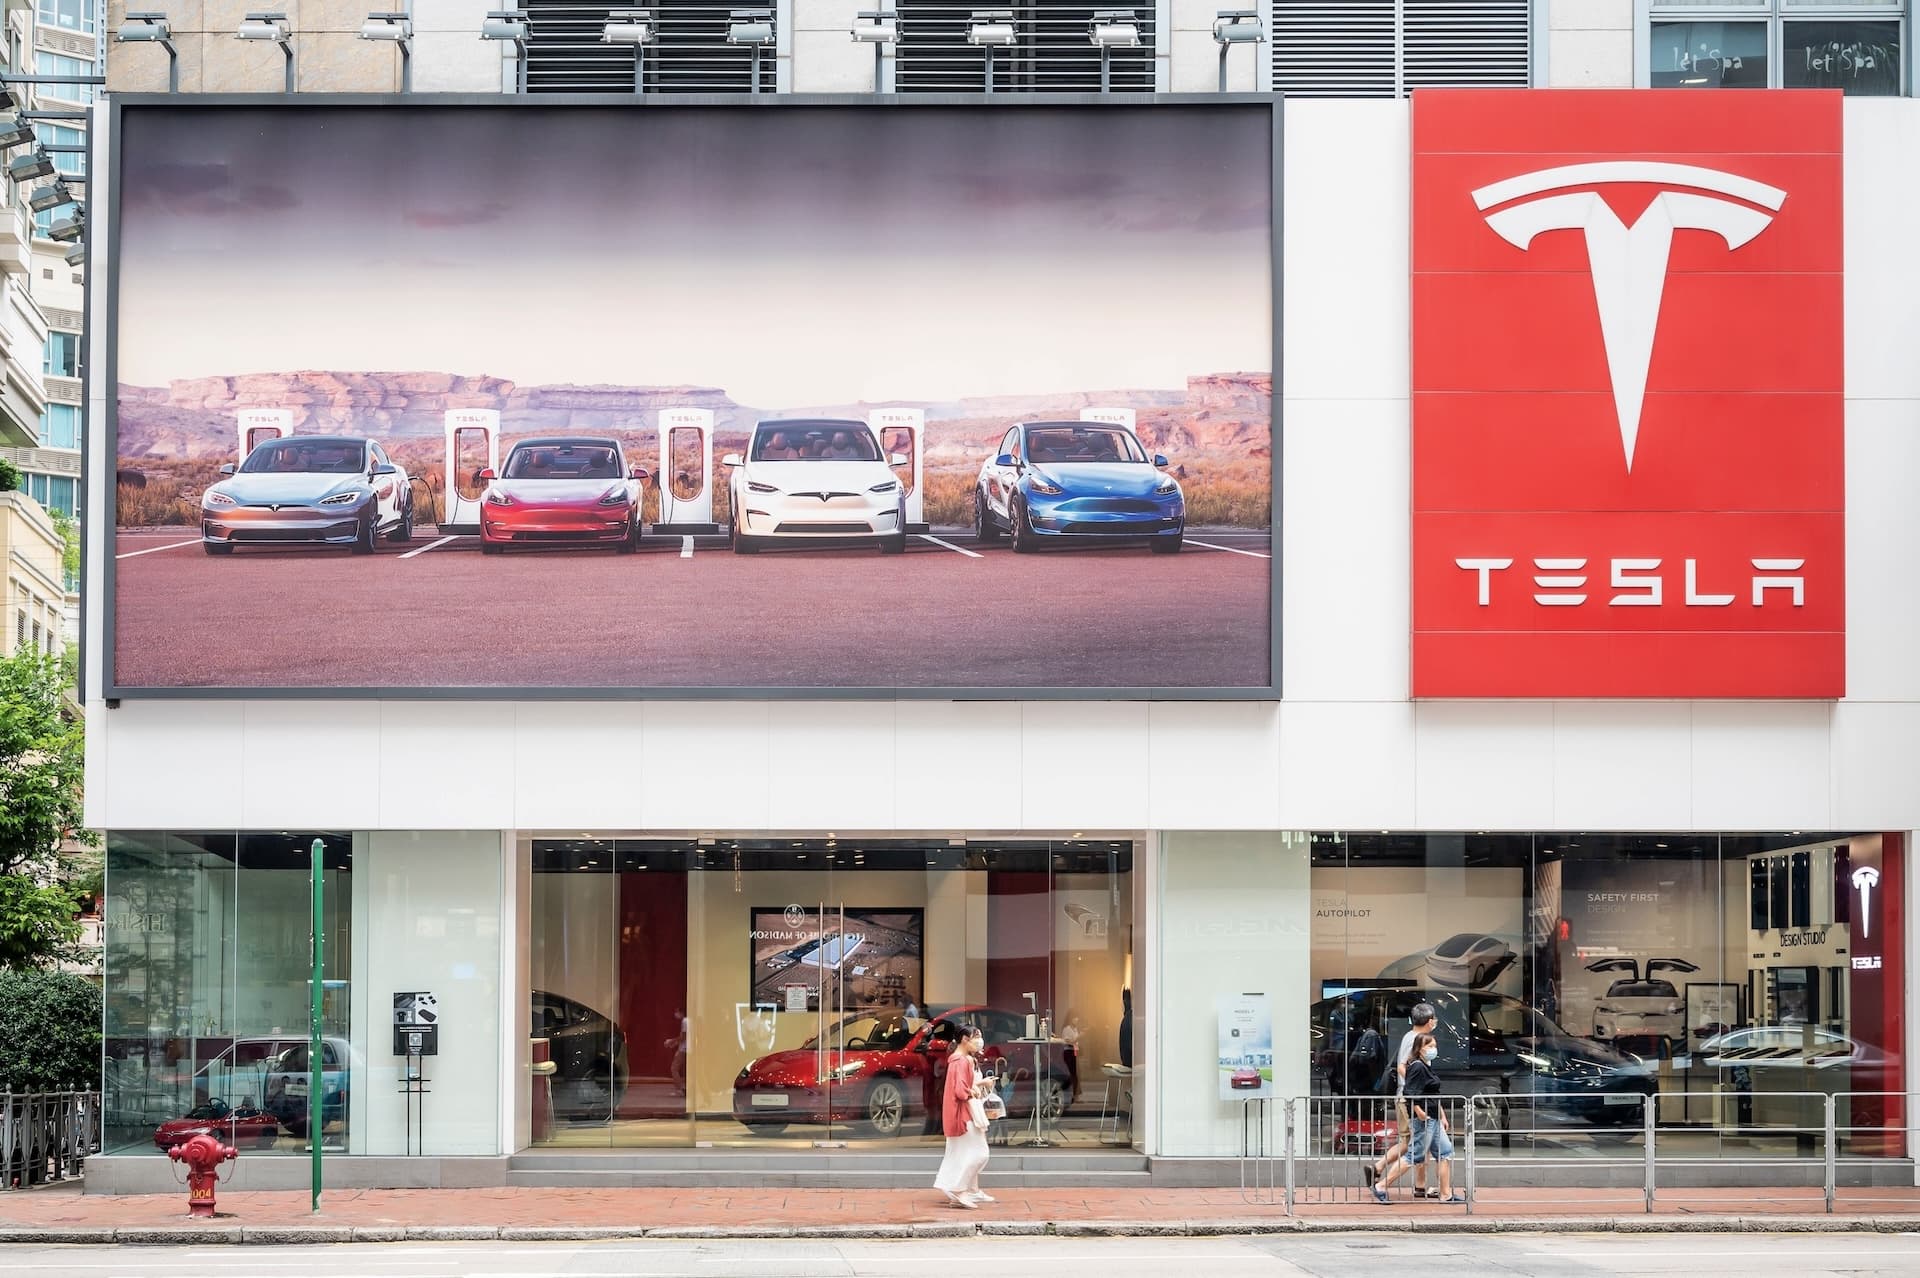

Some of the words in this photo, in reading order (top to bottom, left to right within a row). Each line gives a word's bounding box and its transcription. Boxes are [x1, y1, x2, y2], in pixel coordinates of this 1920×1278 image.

[1455, 558, 1805, 606] TESLA
[1587, 893, 1627, 902] SAFETY
[1630, 893, 1659, 902] FIRST
[1316, 909, 1371, 918] AUTOPILOT
[1780, 933, 1802, 947] DESIGN
[1803, 931, 1826, 946] STUDIO
[1851, 956, 1882, 969] TESLA
